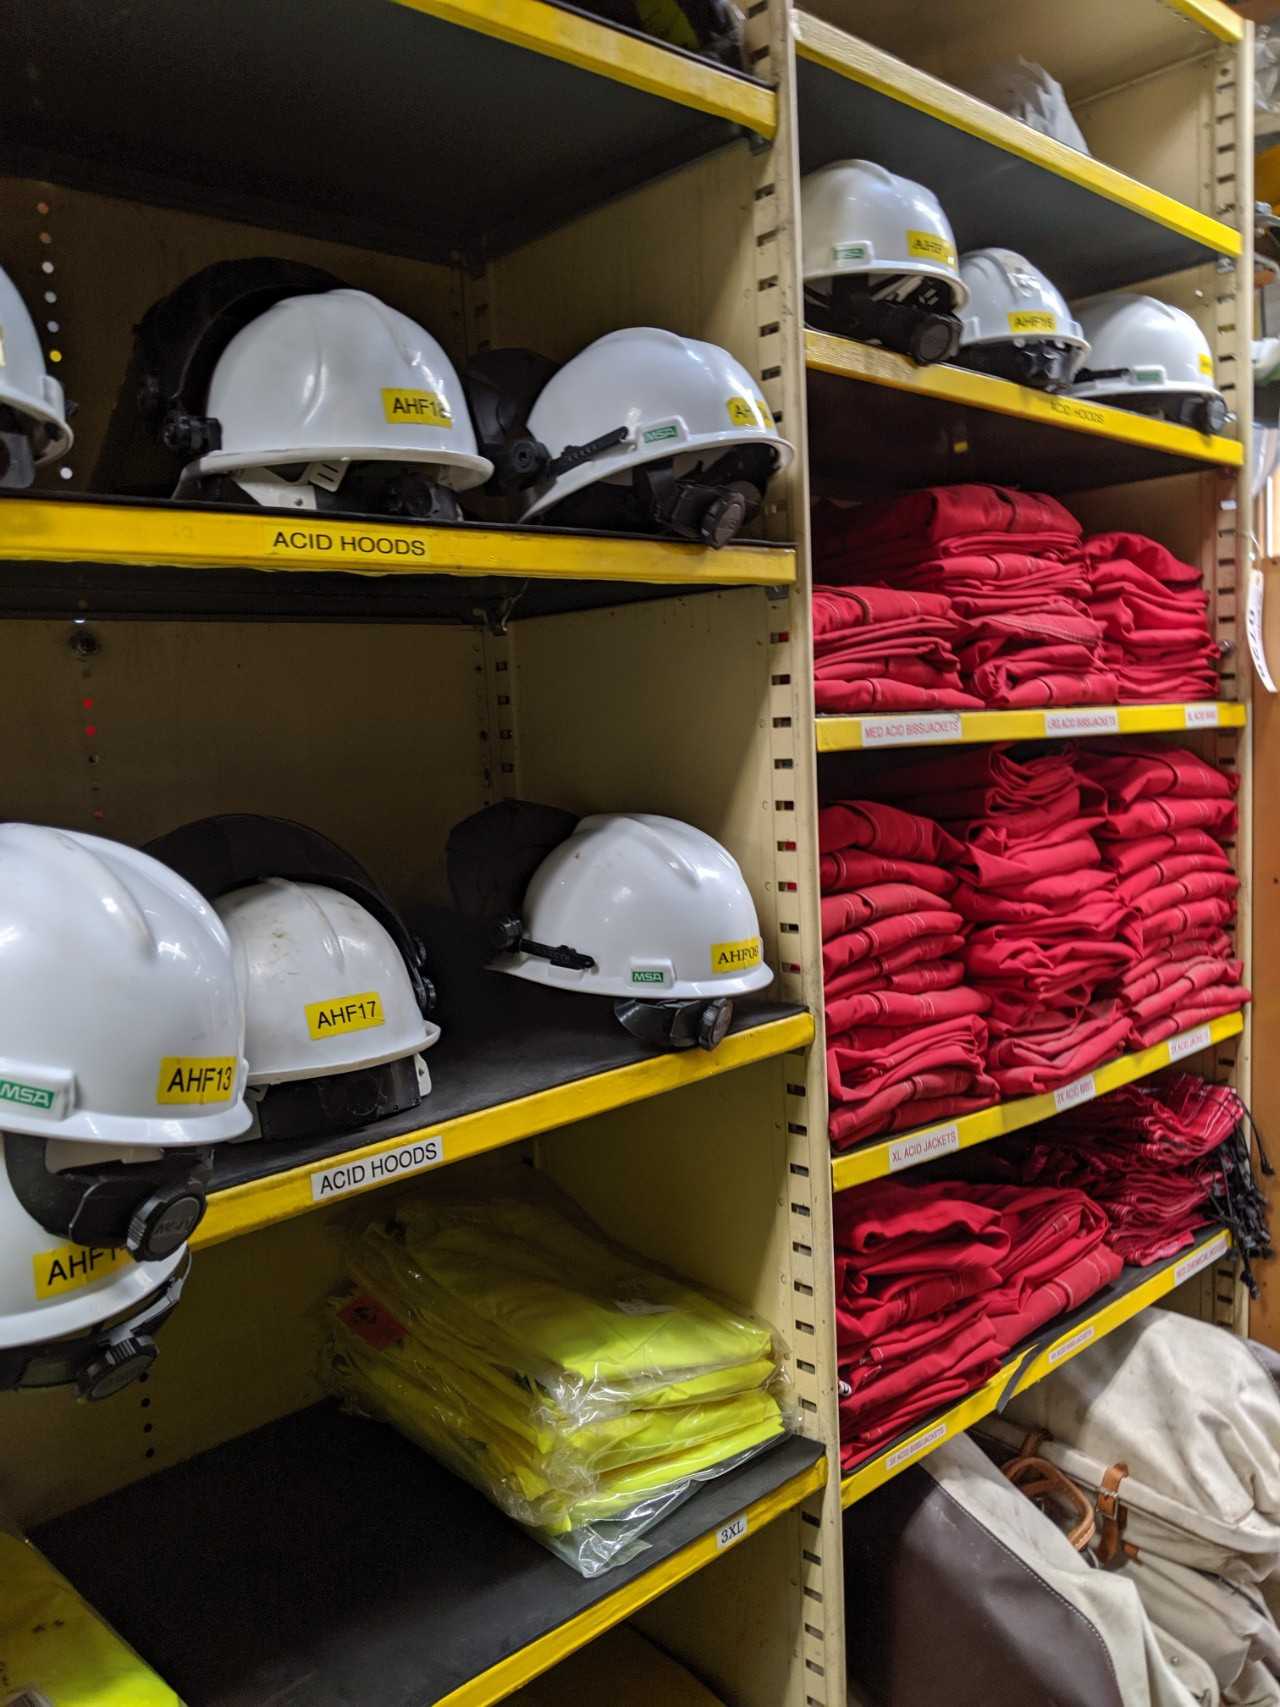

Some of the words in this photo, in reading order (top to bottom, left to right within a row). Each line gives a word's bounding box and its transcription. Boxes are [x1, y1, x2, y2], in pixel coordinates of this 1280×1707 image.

[273, 531, 333, 551] ACID
[340, 536, 425, 556] HOODS
[633, 972, 663, 982] MSA
[317, 1000, 377, 1030] AHF17
[166, 1065, 233, 1093] AHF13
[0, 1083, 50, 1108] MSA
[892, 1150, 902, 1163] XL
[904, 1143, 922, 1159] ACID
[923, 1131, 956, 1153] JACKETS
[320, 1165, 366, 1194] ACID
[370, 1142, 438, 1178] HOODS
[48, 1247, 118, 1286] AHF1
[721, 1520, 745, 1544] 3XL
